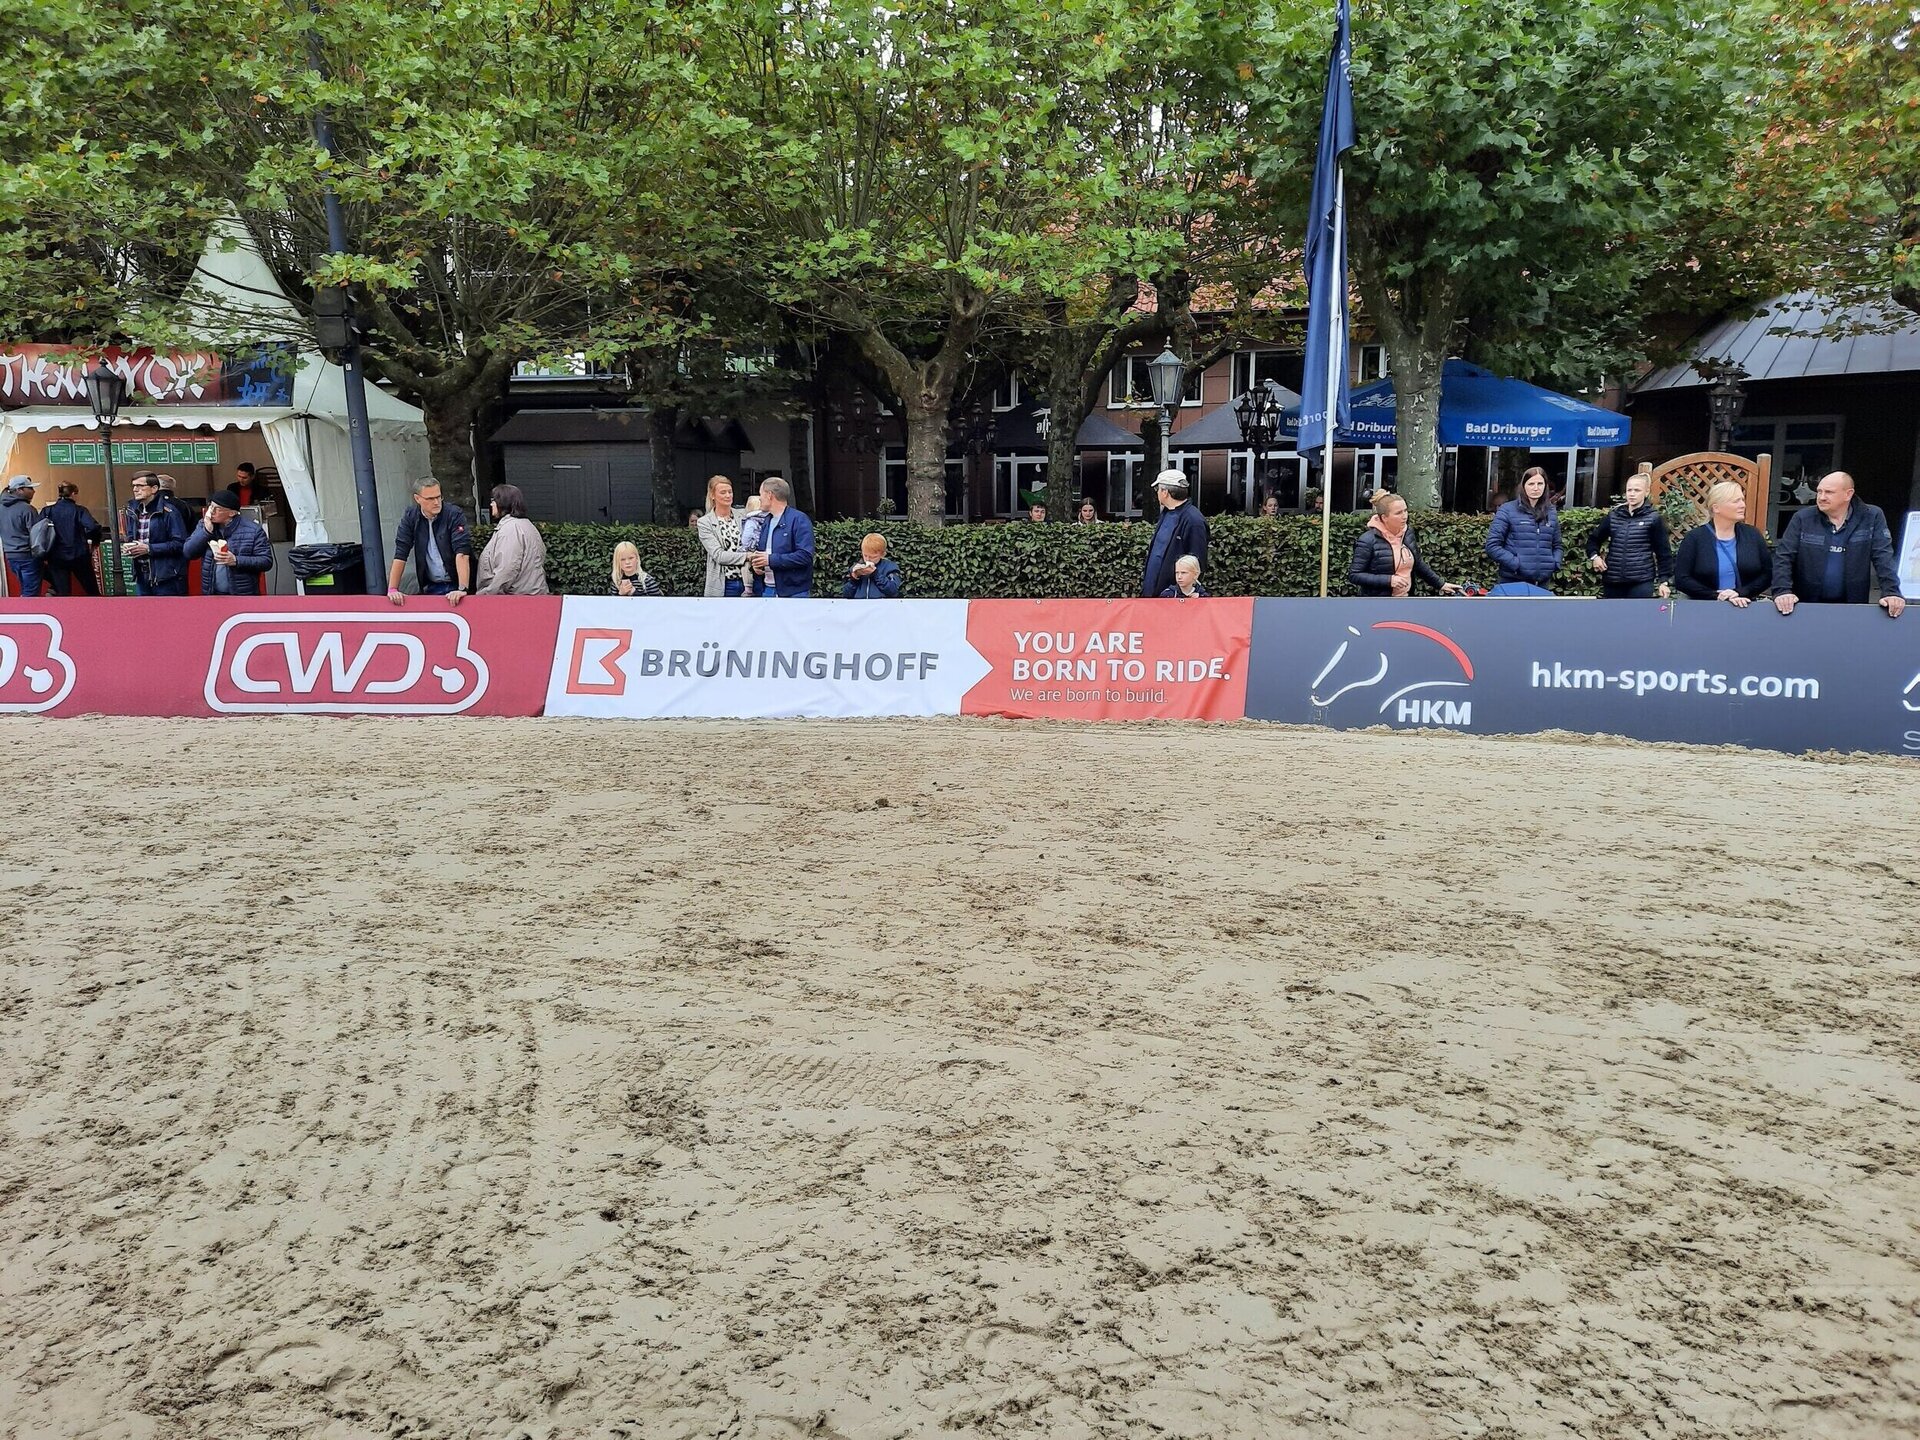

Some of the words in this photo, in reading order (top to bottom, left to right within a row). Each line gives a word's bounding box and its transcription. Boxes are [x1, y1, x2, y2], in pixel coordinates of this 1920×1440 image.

[1466, 423, 1489, 434] Bad
[1491, 423, 1552, 437] Driburger
[1014, 631, 1075, 653] YOU
[1085, 632, 1144, 654] ARE
[230, 632, 426, 693] CWD
[640, 642, 939, 681] BRÜNINGHOFF
[1013, 659, 1097, 681] BORN
[1106, 660, 1146, 682] TO
[1156, 657, 1231, 682] RIDE.
[1532, 661, 1819, 699] hkm-sports.com
[1010, 688, 1034, 701] We
[1038, 691, 1061, 702] are
[1067, 688, 1100, 702] born
[1106, 689, 1120, 702] to
[1126, 689, 1168, 703] build.
[1397, 699, 1472, 726] HKM
